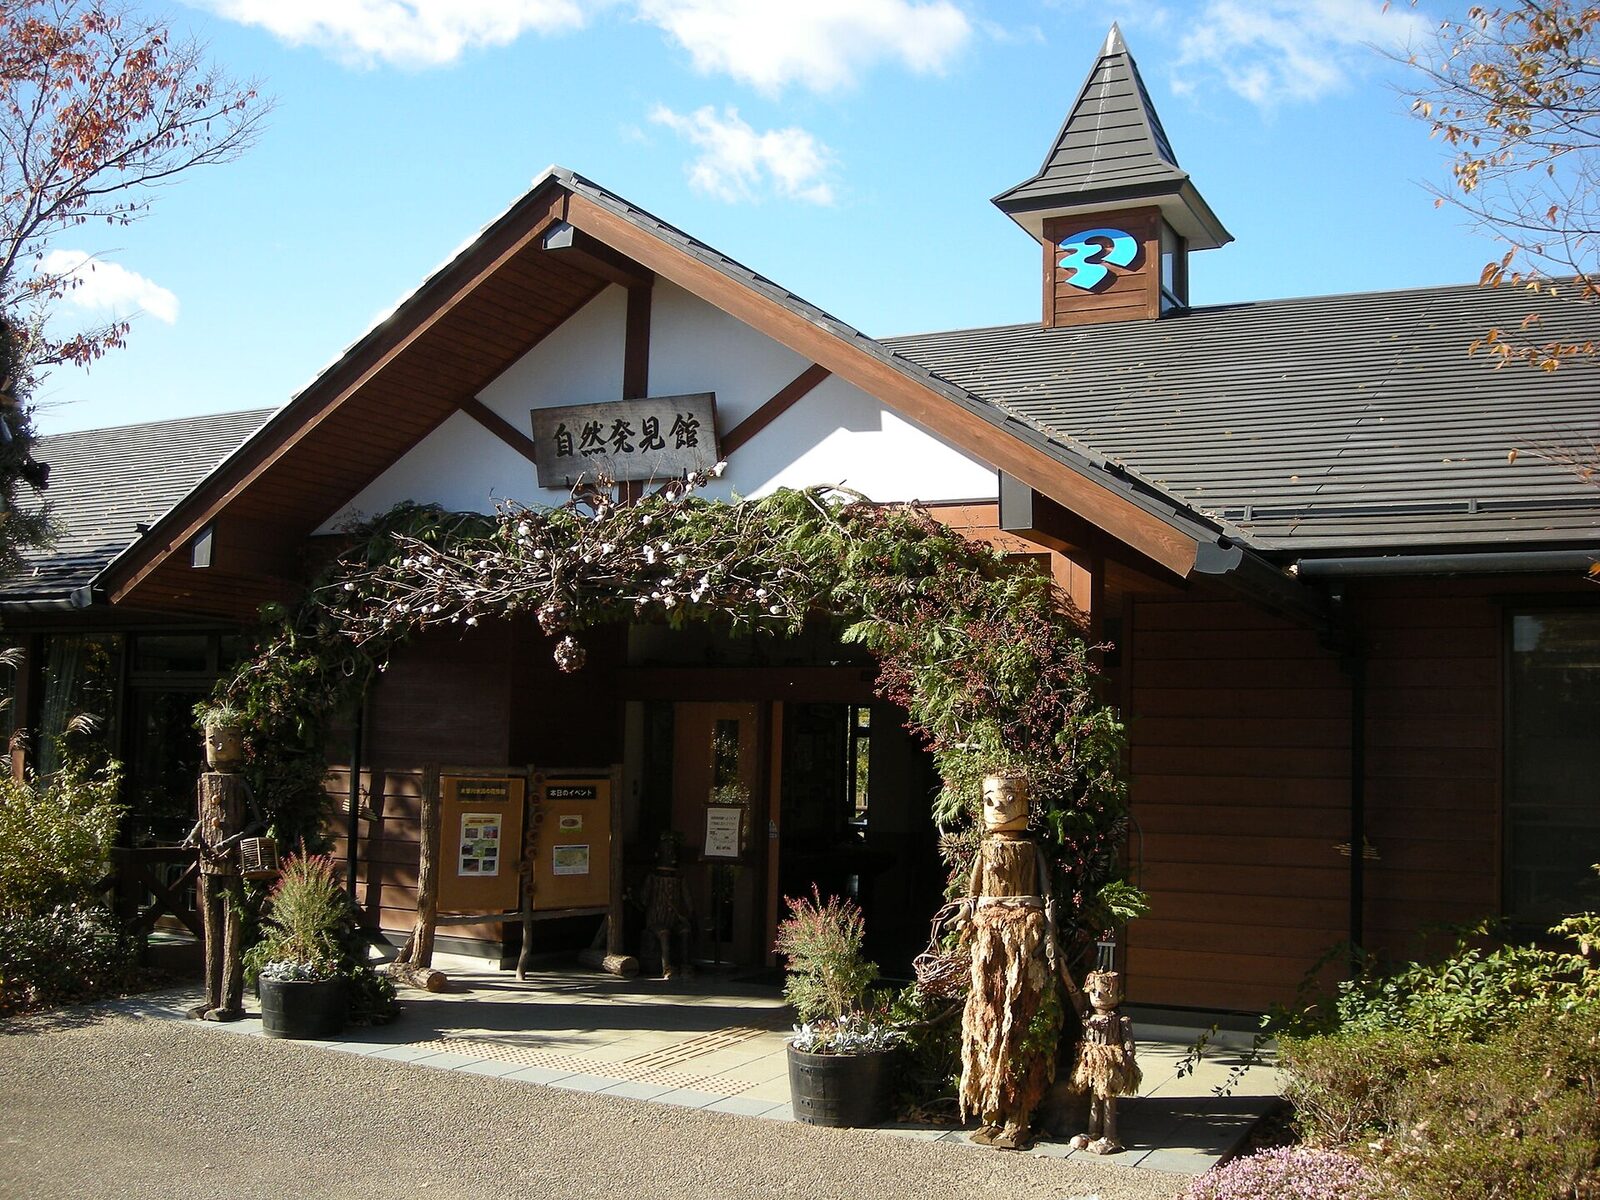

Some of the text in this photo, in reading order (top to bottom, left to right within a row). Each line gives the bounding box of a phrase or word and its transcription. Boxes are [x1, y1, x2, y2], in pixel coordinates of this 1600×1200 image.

[553, 412, 700, 458] 自然発見館
[550, 789, 592, 797] 本日のイベント
